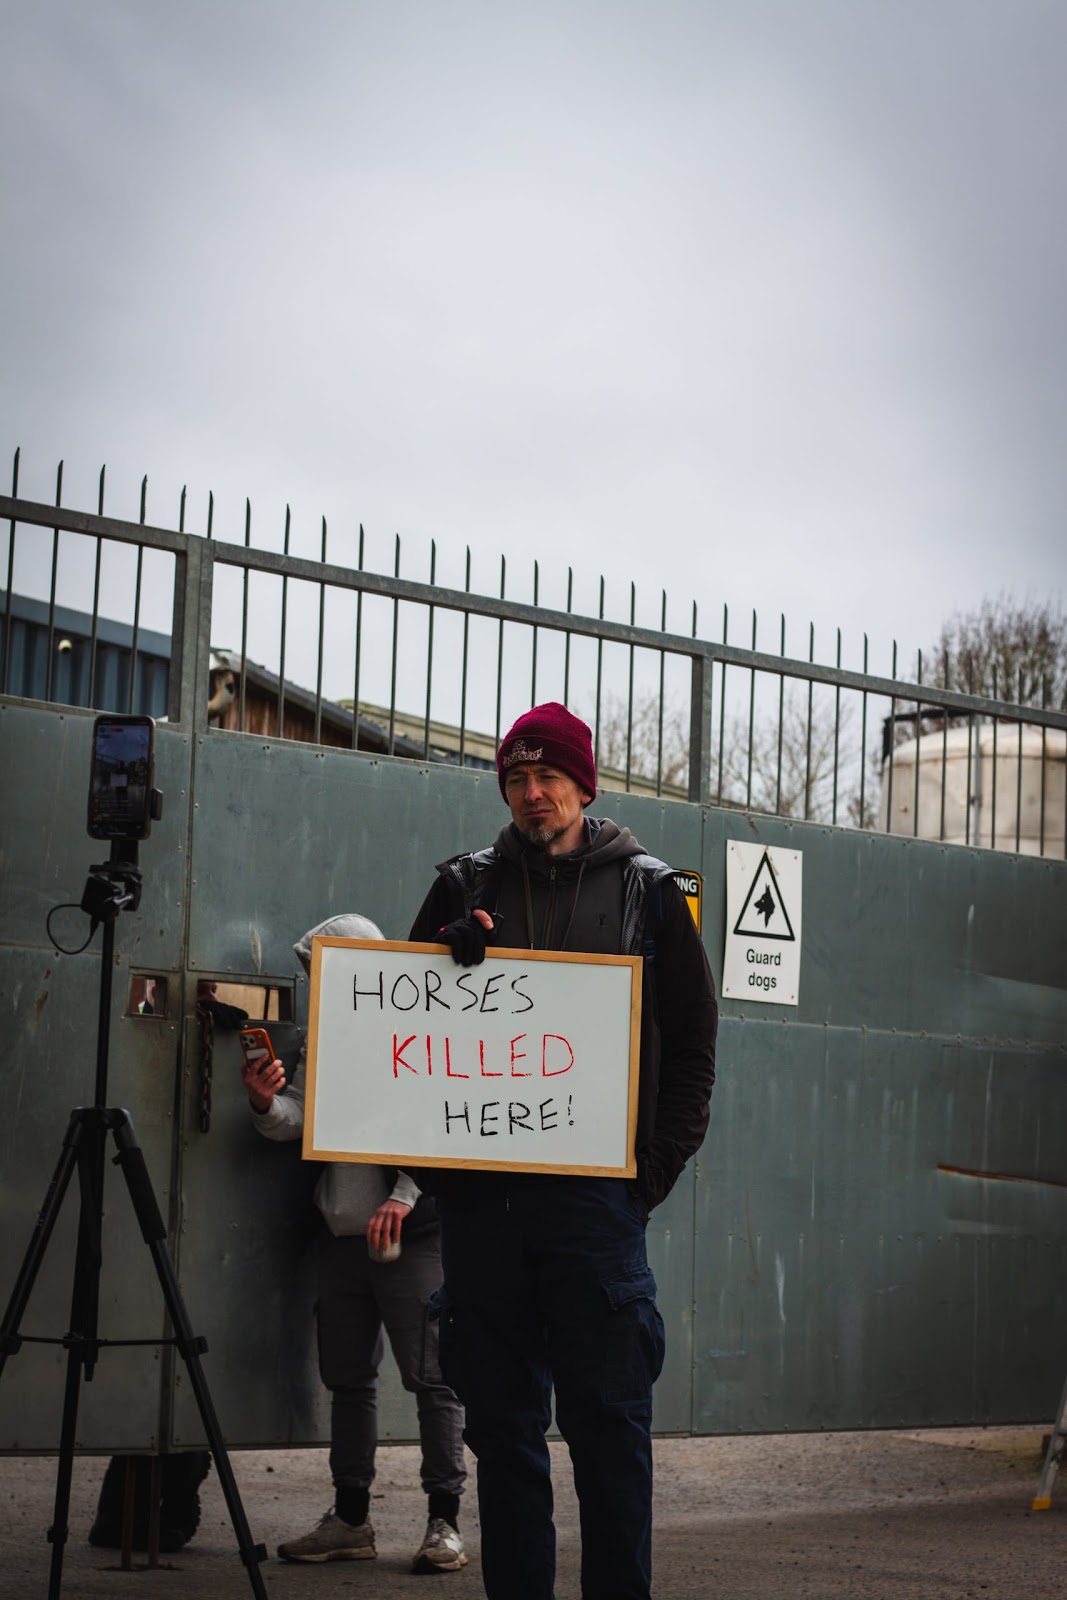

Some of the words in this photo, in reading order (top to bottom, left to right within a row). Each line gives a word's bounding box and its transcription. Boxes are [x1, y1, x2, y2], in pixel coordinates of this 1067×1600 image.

[673, 876, 697, 893] ING
[746, 949, 781, 966] Guard
[353, 970, 534, 1013] HORSES
[749, 972, 777, 991] dogs
[392, 1033, 575, 1079] KILLED
[444, 1095, 575, 1137] HERE!
